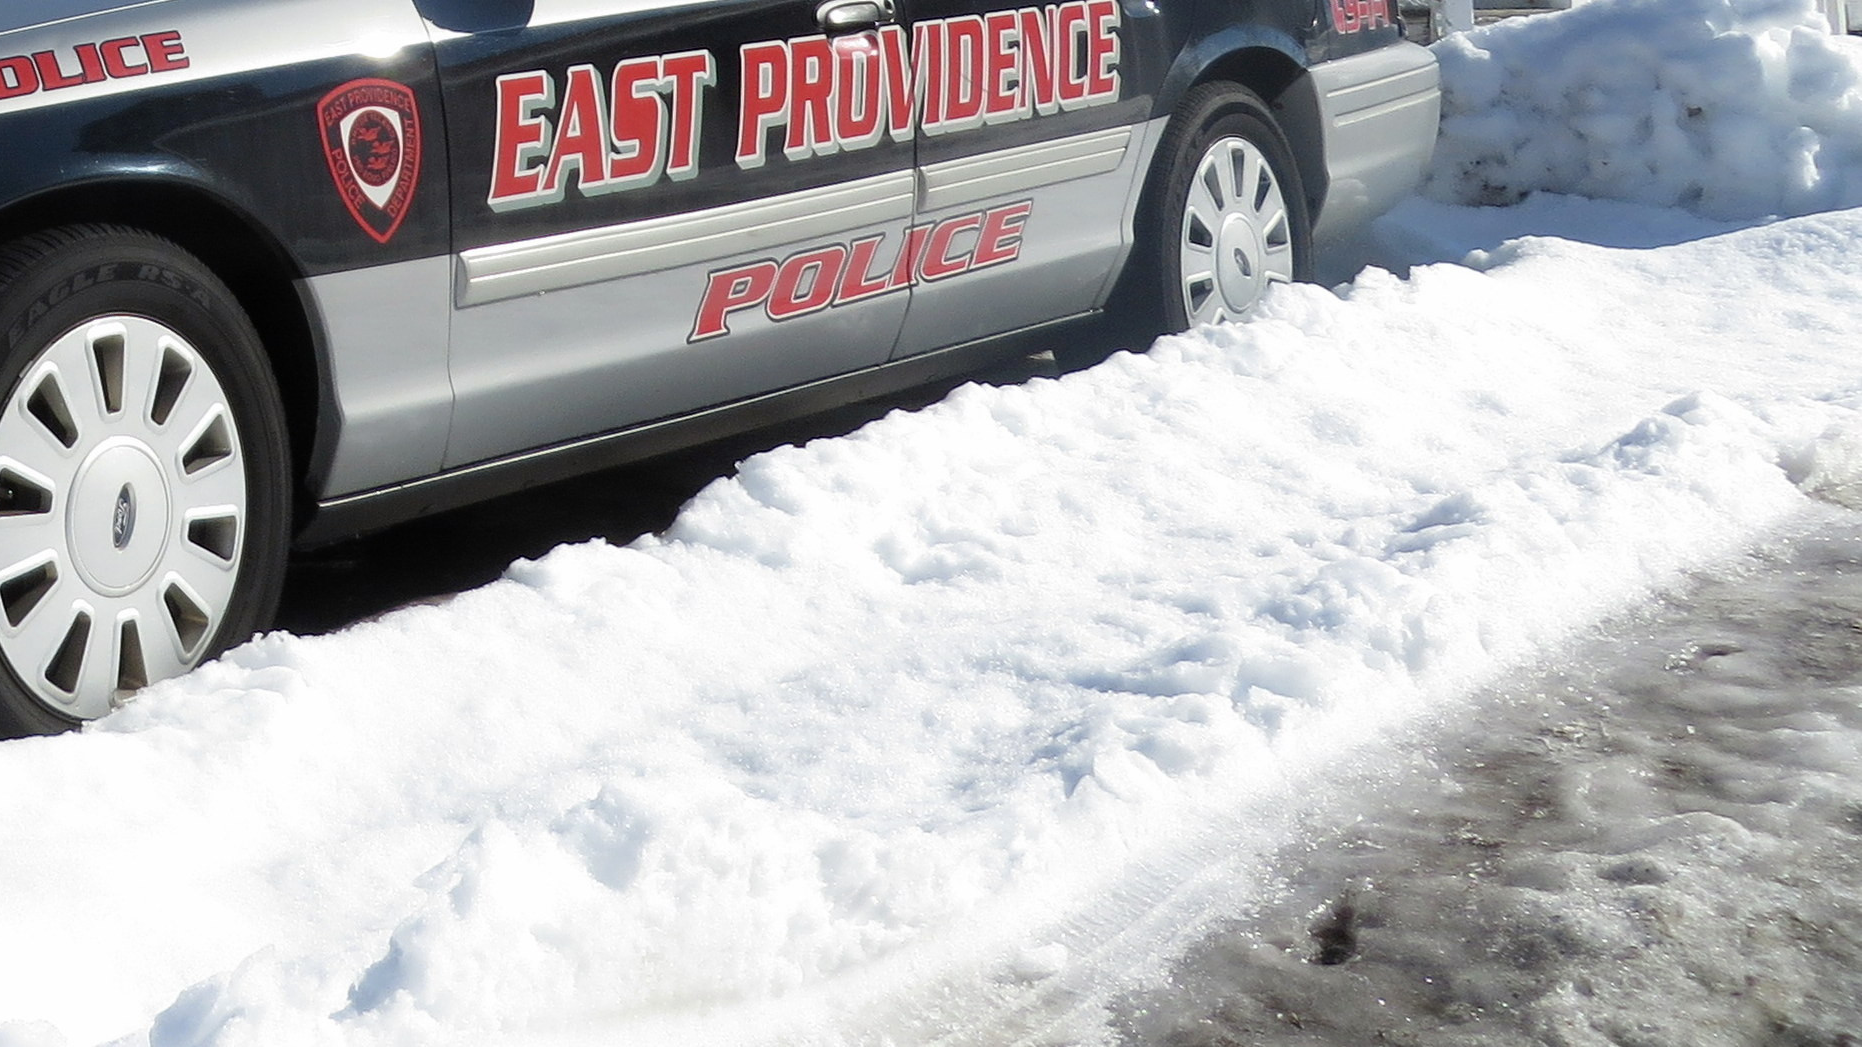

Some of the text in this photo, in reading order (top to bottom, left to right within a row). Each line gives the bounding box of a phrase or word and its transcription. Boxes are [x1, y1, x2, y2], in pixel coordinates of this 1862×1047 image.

[324, 87, 412, 126] EAST PROVIDENCE
[488, 49, 717, 213] EAST
[331, 148, 368, 210] POLICE
[387, 118, 416, 218] DEPARTMENT
[8, 263, 118, 349] EAGLE
[687, 198, 1034, 344] POLICE
